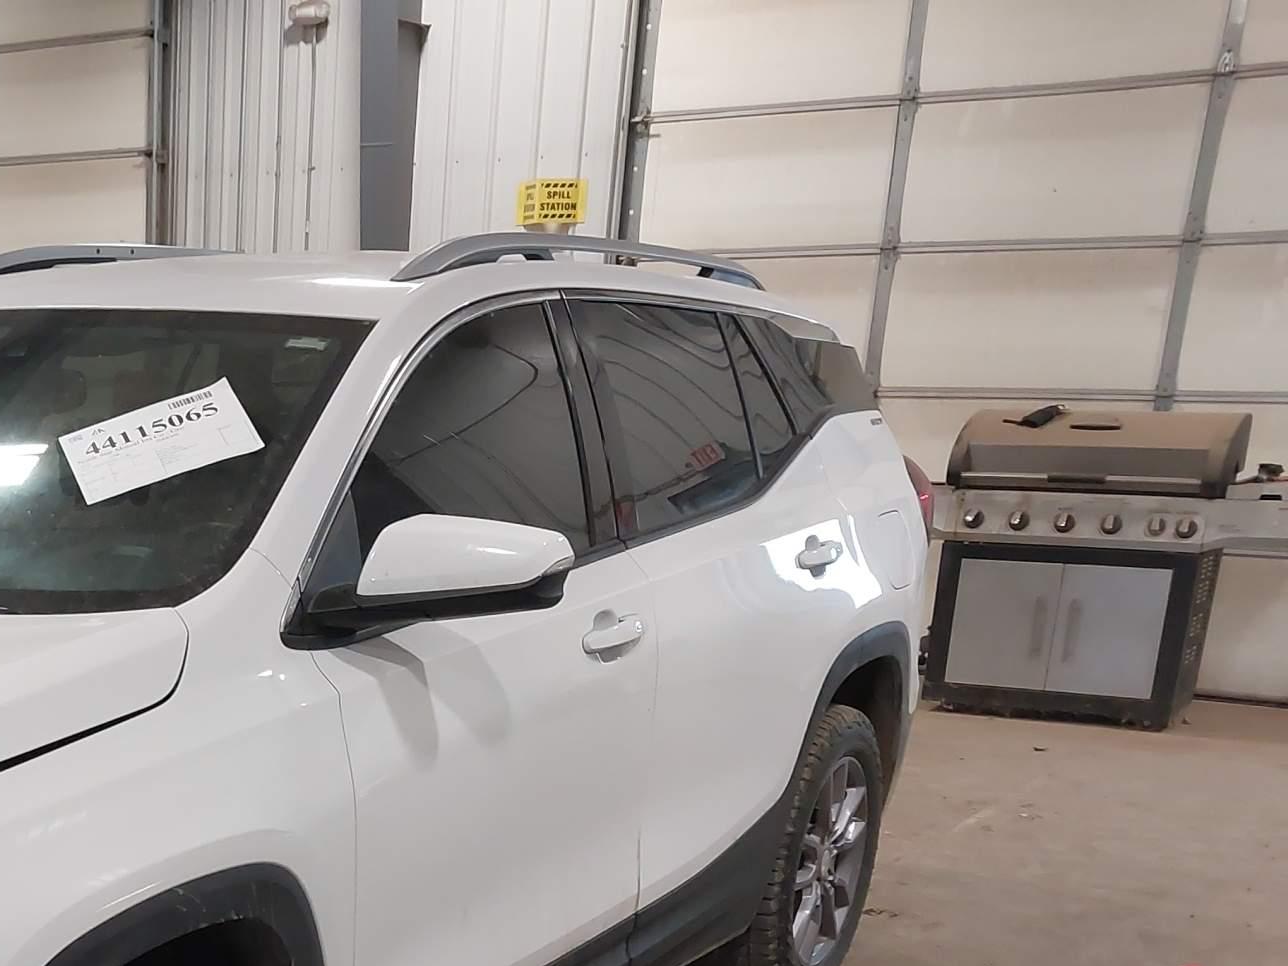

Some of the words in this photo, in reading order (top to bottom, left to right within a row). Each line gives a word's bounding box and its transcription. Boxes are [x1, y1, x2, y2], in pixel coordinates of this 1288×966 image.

[546, 190, 571, 200] SPILL
[539, 202, 577, 211] STATION
[85, 402, 219, 456] 44115065
